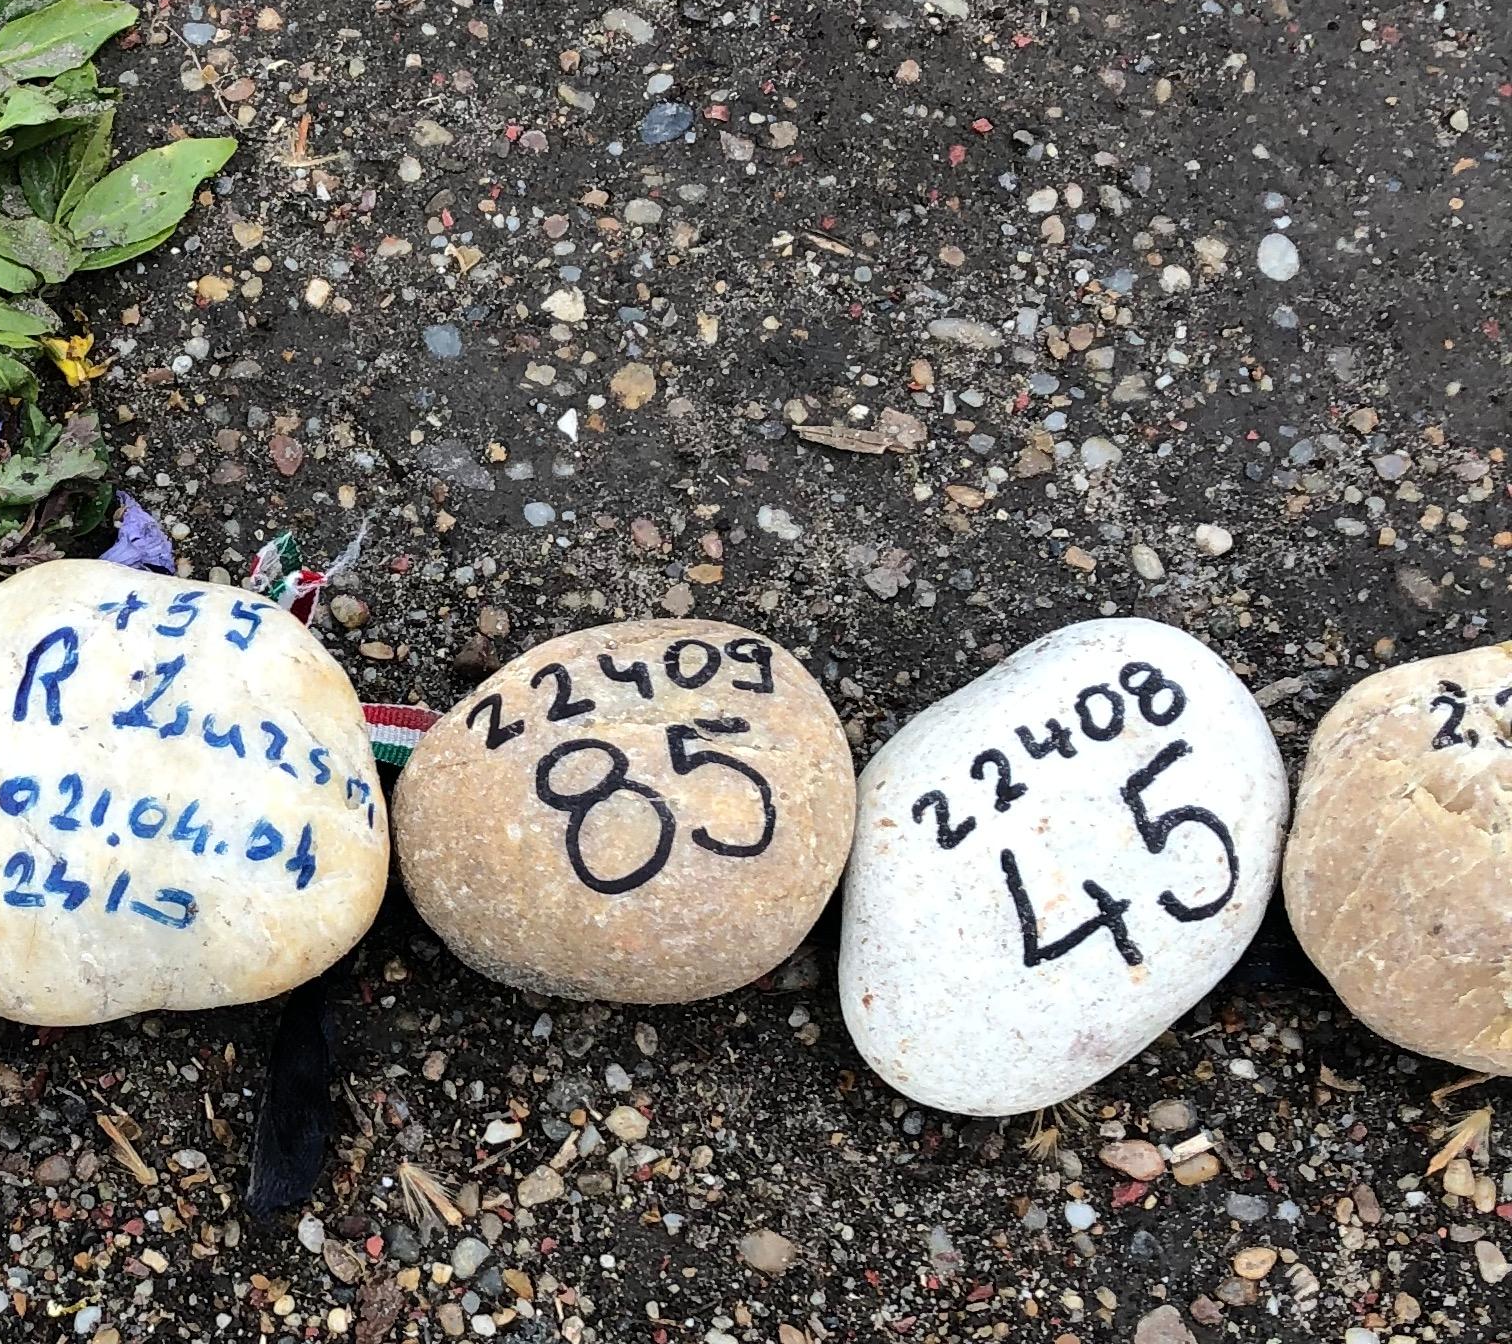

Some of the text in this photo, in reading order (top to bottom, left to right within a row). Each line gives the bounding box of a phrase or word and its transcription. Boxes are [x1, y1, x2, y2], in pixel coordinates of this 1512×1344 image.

[12, 626, 79, 725] R
[466, 638, 775, 749] 22409
[1429, 680, 1512, 751] 2
[535, 717, 776, 895] 85
[912, 661, 1187, 850] 22408
[1000, 739, 1241, 968] 45
